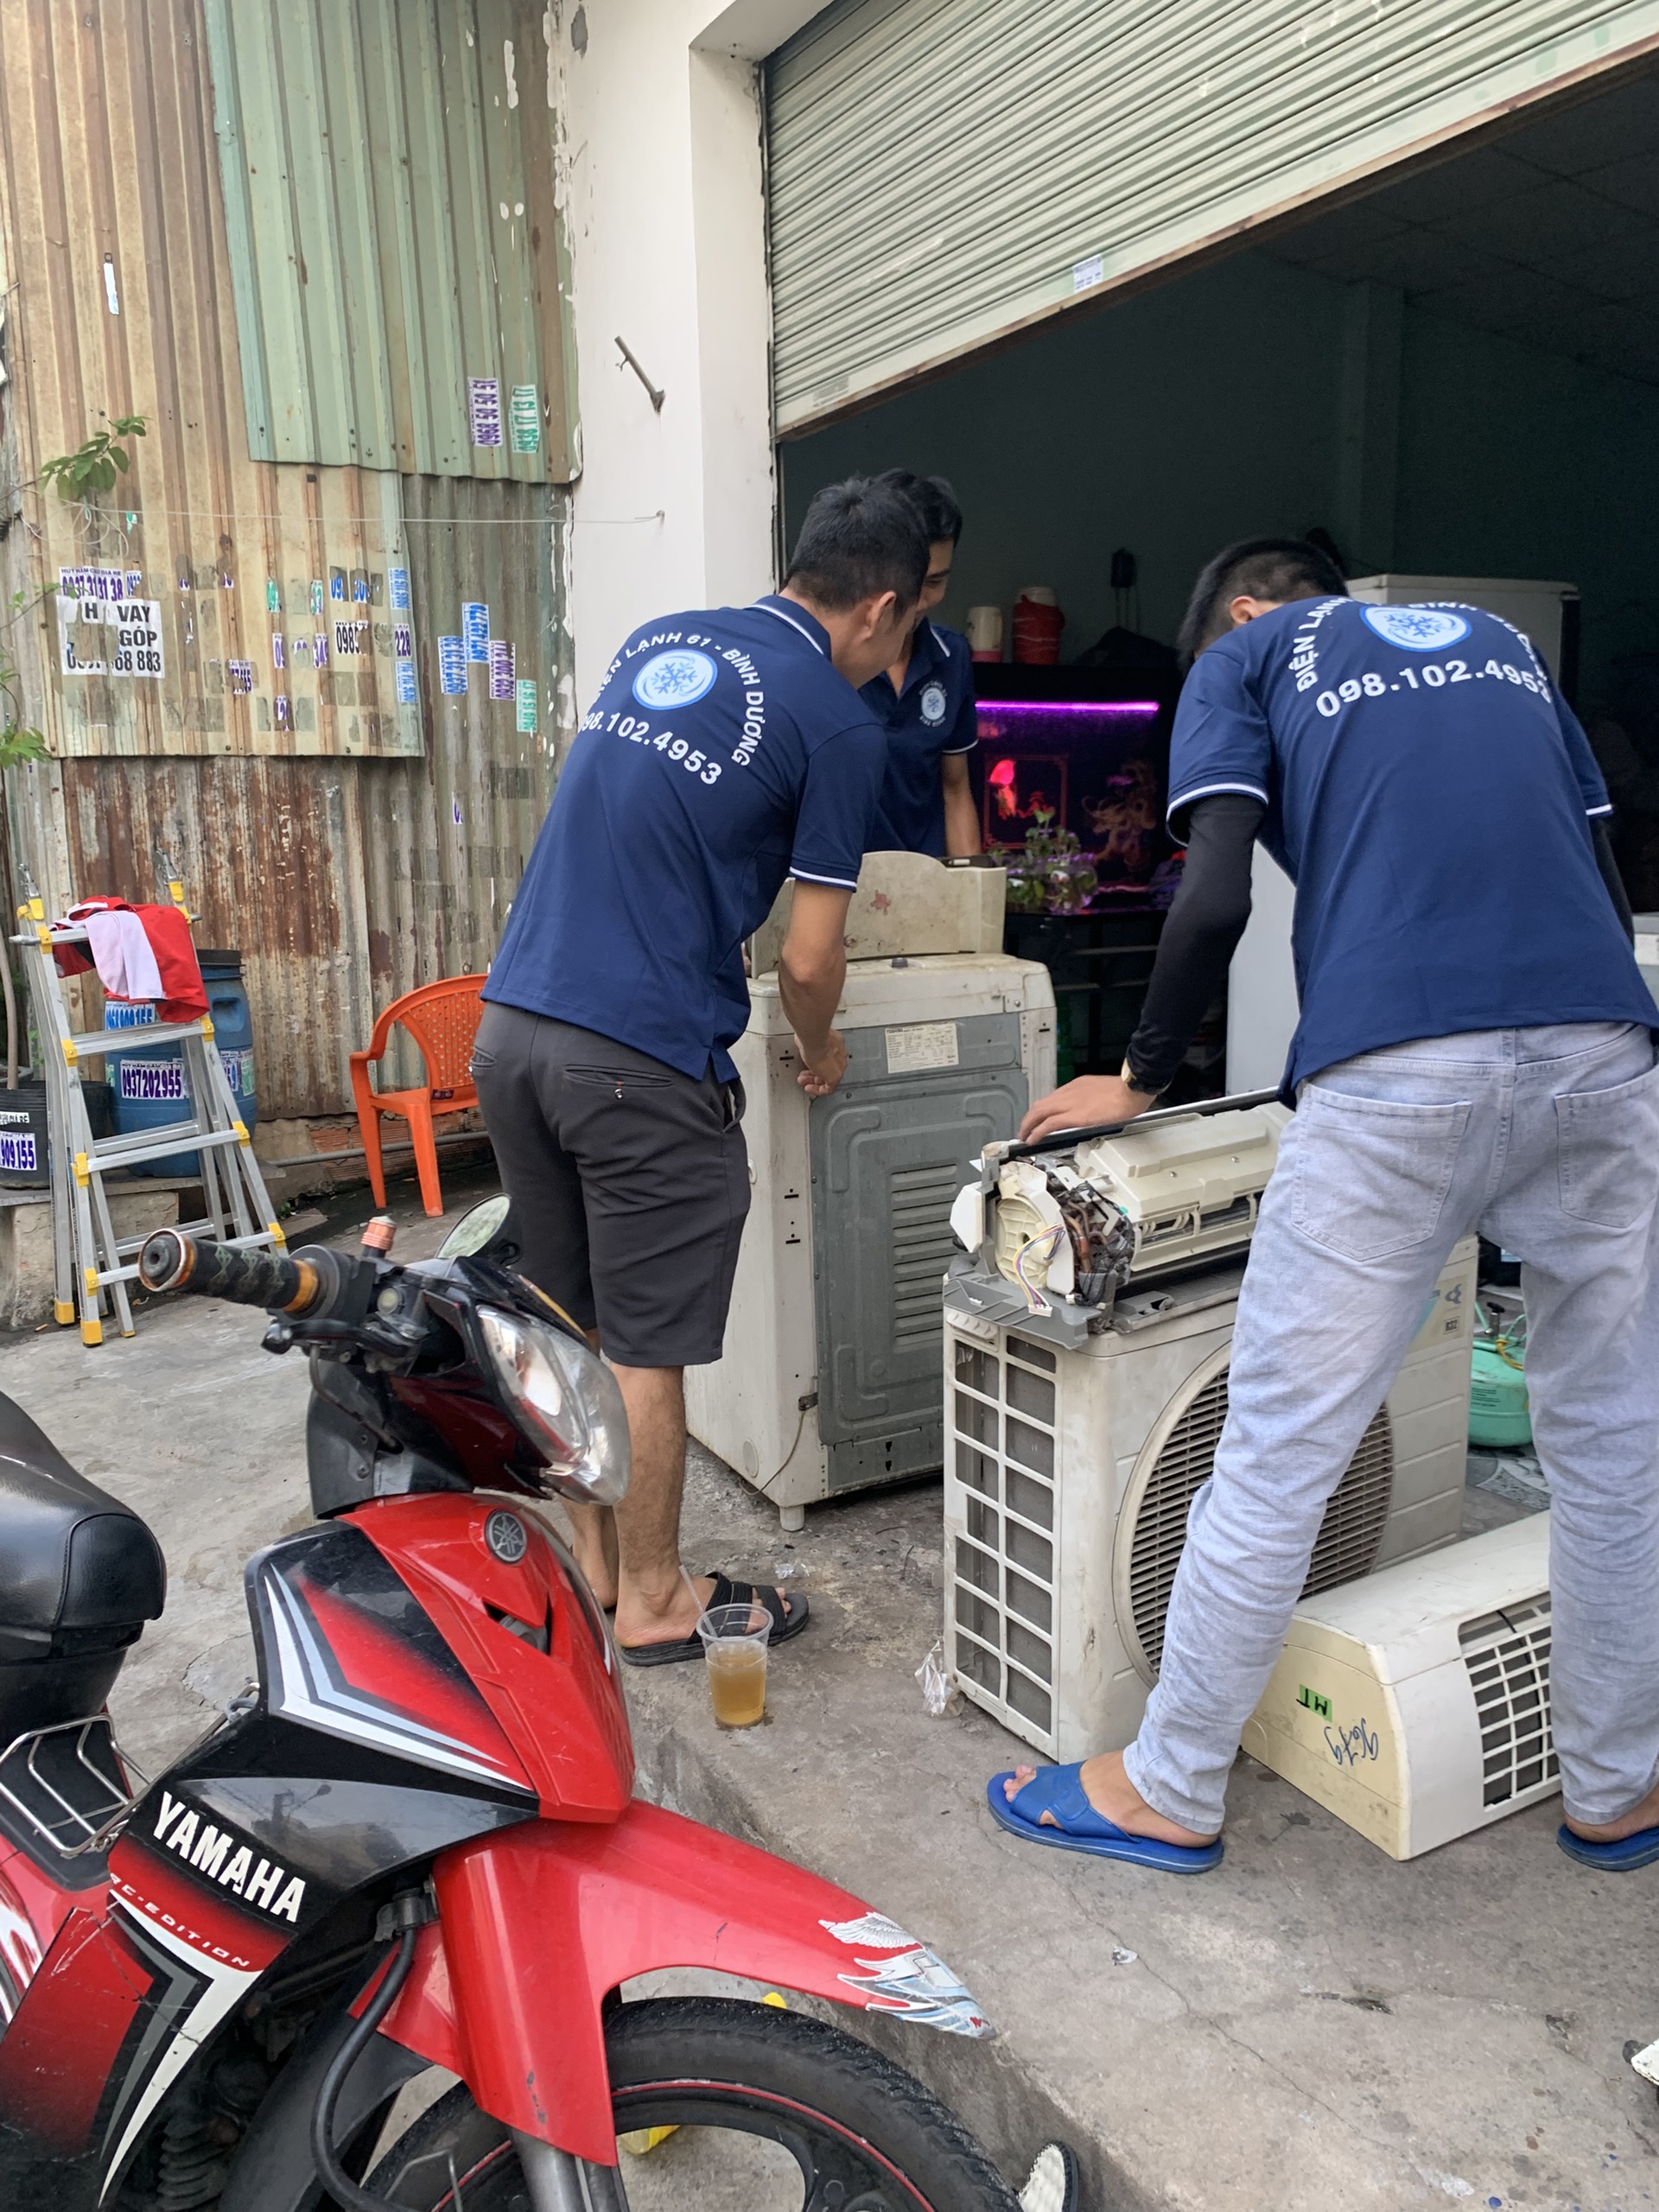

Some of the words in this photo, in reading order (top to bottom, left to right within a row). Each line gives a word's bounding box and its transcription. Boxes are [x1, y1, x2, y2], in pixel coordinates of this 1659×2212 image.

[117, 605, 150, 622] VAY
[119, 626, 157, 646] GÓP
[626, 632, 683, 658] LẠNH
[686, 634, 712, 647] 61
[721, 648, 760, 685] BÌNH
[731, 691, 766, 766] DƯƠNG
[578, 711, 723, 785] 98.102.4953
[153, 1791, 307, 1923] YAMAHA
